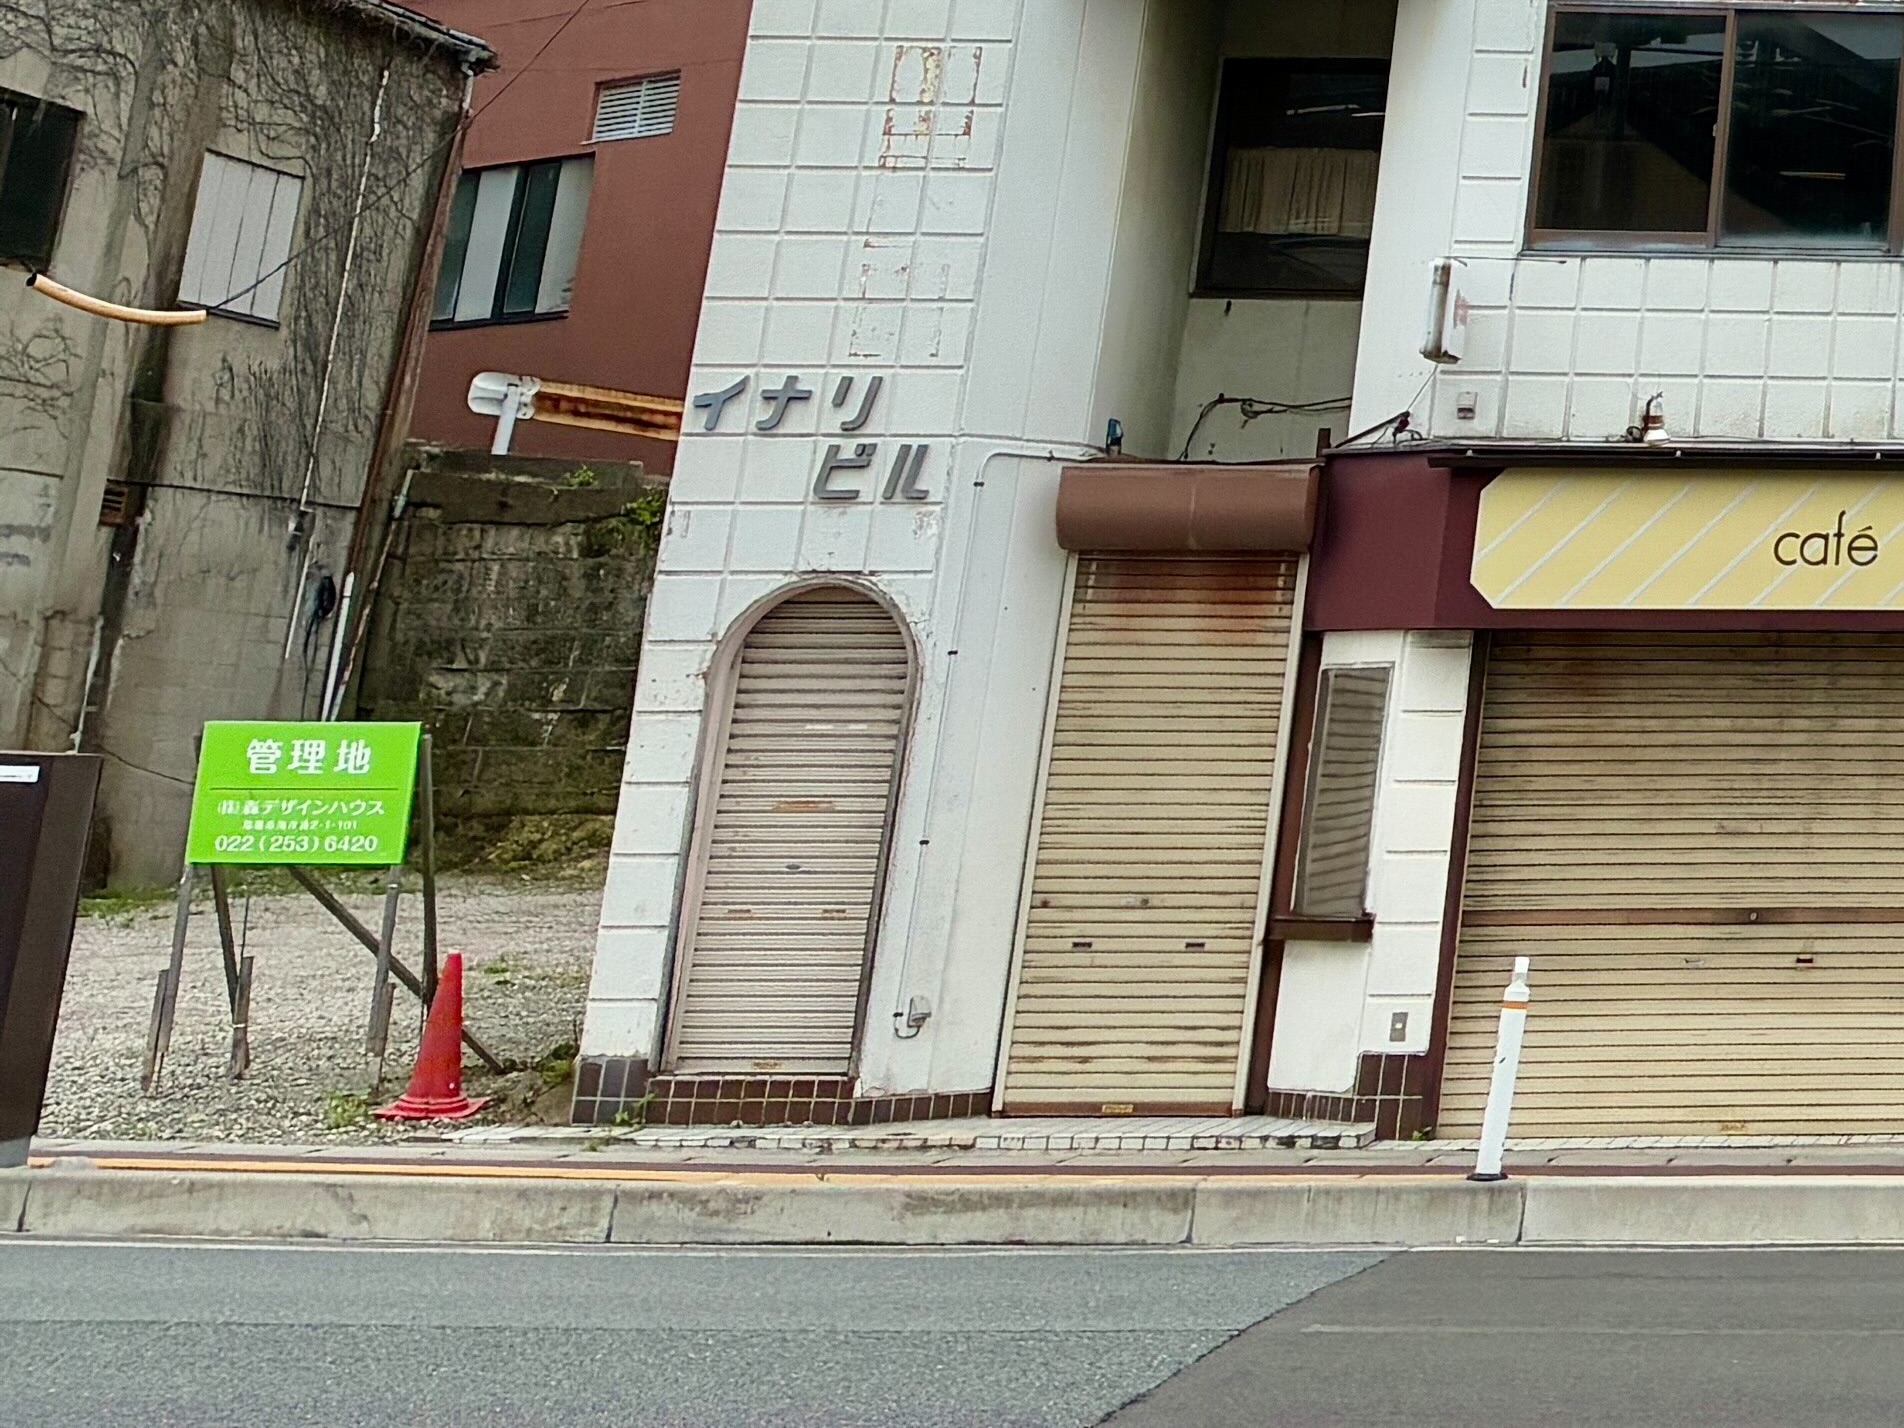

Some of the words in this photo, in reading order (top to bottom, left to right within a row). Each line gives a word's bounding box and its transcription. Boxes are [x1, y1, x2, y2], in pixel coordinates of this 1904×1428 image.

[693, 375, 884, 432] イナリ
[812, 443, 931, 501] ビル
[1773, 510, 1879, 568] café
[246, 738, 372, 775] 管理地
